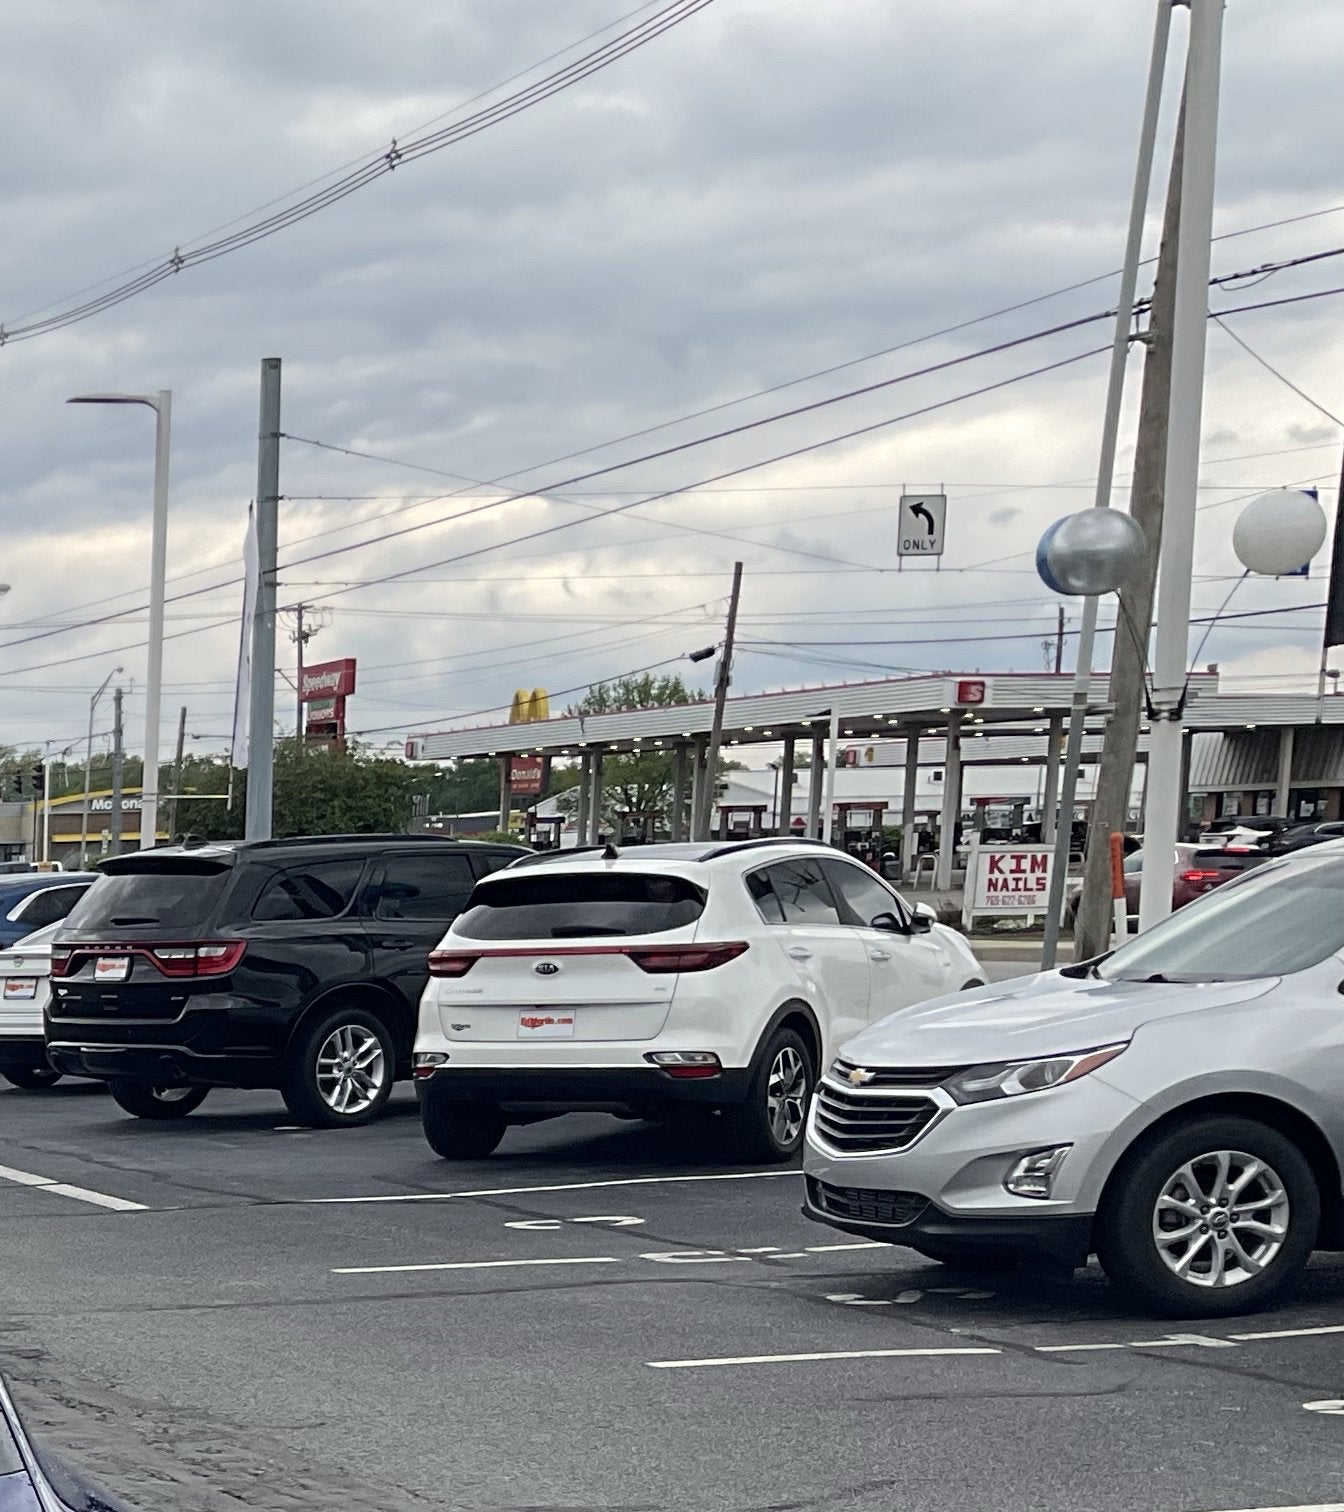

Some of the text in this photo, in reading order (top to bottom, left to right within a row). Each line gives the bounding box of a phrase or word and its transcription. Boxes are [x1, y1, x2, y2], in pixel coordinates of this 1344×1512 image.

[903, 539, 937, 551] ONLY
[988, 854, 1048, 875] KIM
[987, 877, 1047, 892] NAILS
